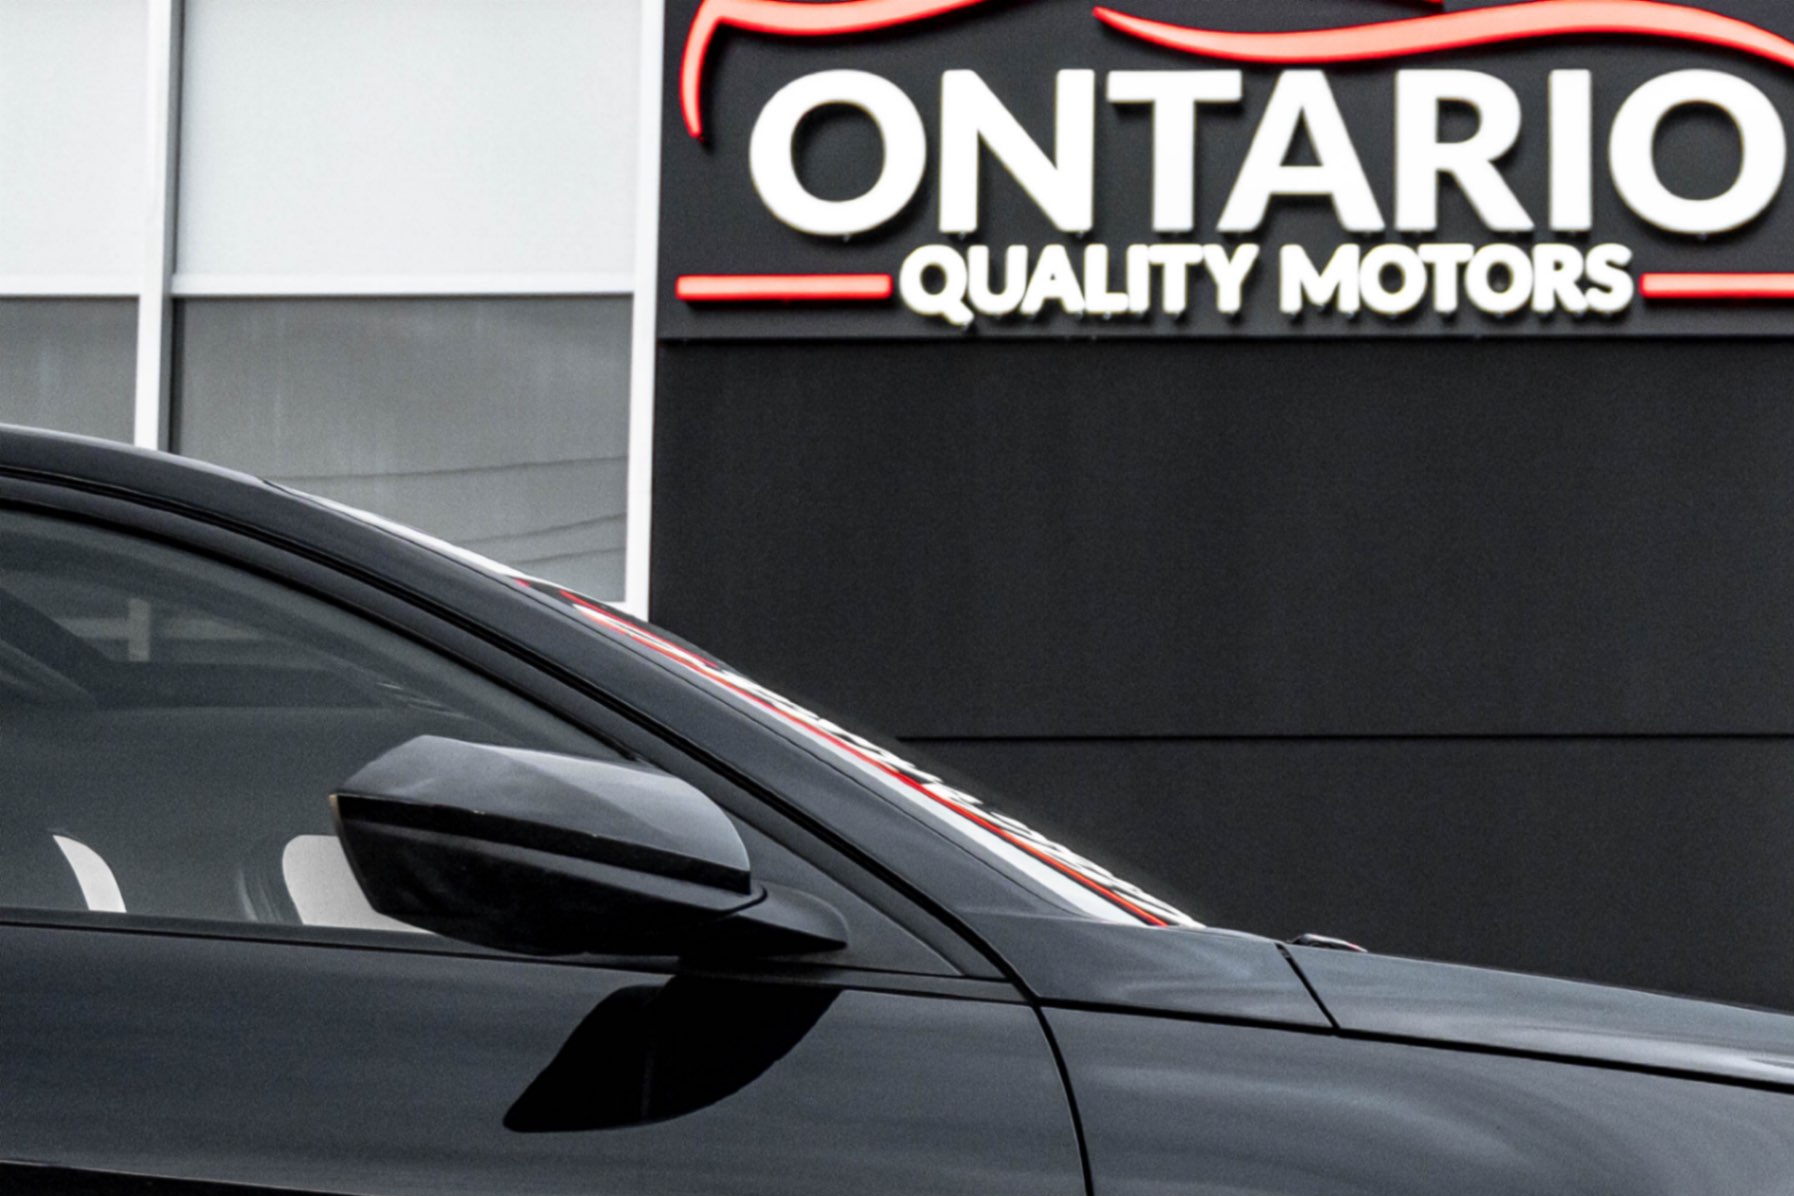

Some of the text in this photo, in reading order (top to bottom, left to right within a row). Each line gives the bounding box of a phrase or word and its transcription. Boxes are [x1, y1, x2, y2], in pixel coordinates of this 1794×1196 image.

[749, 68, 1787, 237] ONTARIO
[898, 242, 1634, 323] QUALITY MOTORS
